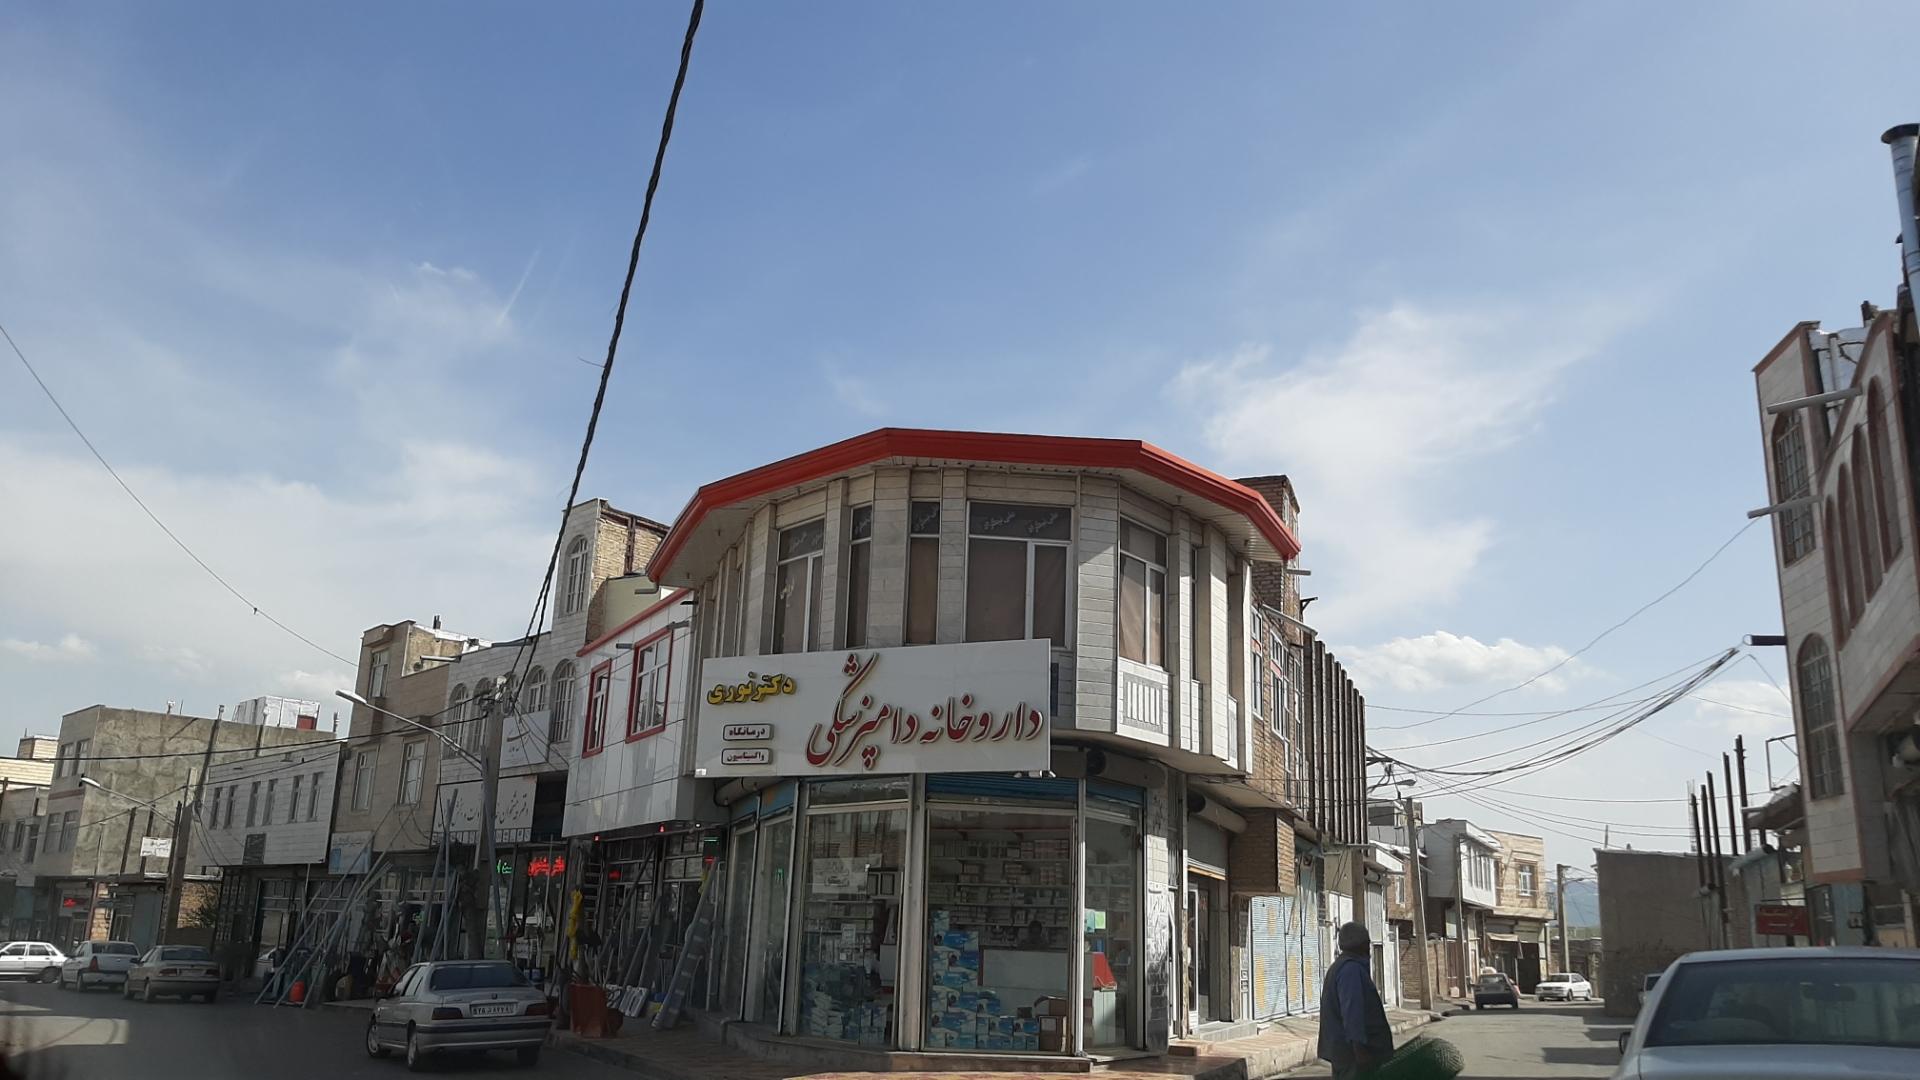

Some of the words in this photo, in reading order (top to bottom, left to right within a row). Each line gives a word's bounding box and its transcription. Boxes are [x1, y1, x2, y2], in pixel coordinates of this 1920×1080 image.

[707, 671, 754, 705] نوری
[751, 673, 797, 702] دکتر
[806, 652, 919, 770] دامپزشکی
[919, 693, 1044, 744] داروخانه
